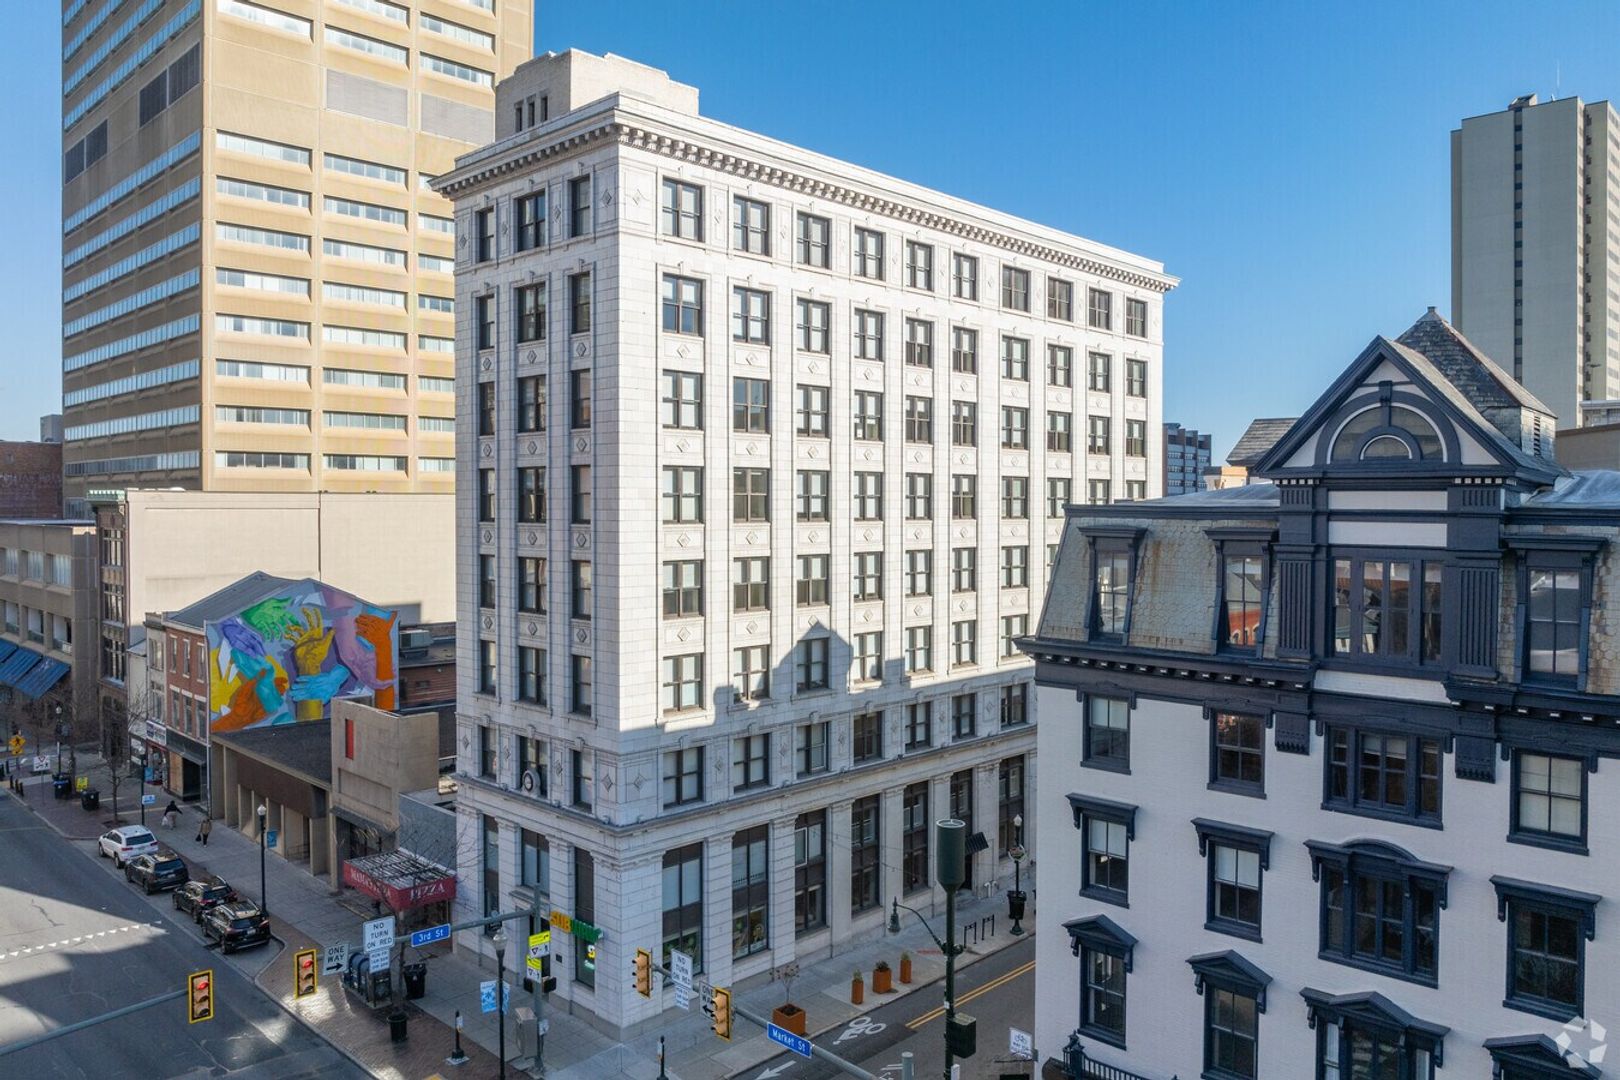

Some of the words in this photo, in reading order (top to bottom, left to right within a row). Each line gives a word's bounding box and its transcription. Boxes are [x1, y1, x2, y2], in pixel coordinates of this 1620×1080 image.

[410, 882, 445, 901] PIZZA
[373, 922, 384, 930] NO
[370, 930, 389, 939] TURN
[418, 931, 431, 942] 3rd
[435, 929, 443, 938] St
[379, 937, 393, 945] RED
[328, 945, 344, 956] ONE
[327, 953, 345, 964] WAY
[772, 1028, 795, 1047] Market
[797, 1040, 806, 1052] St
